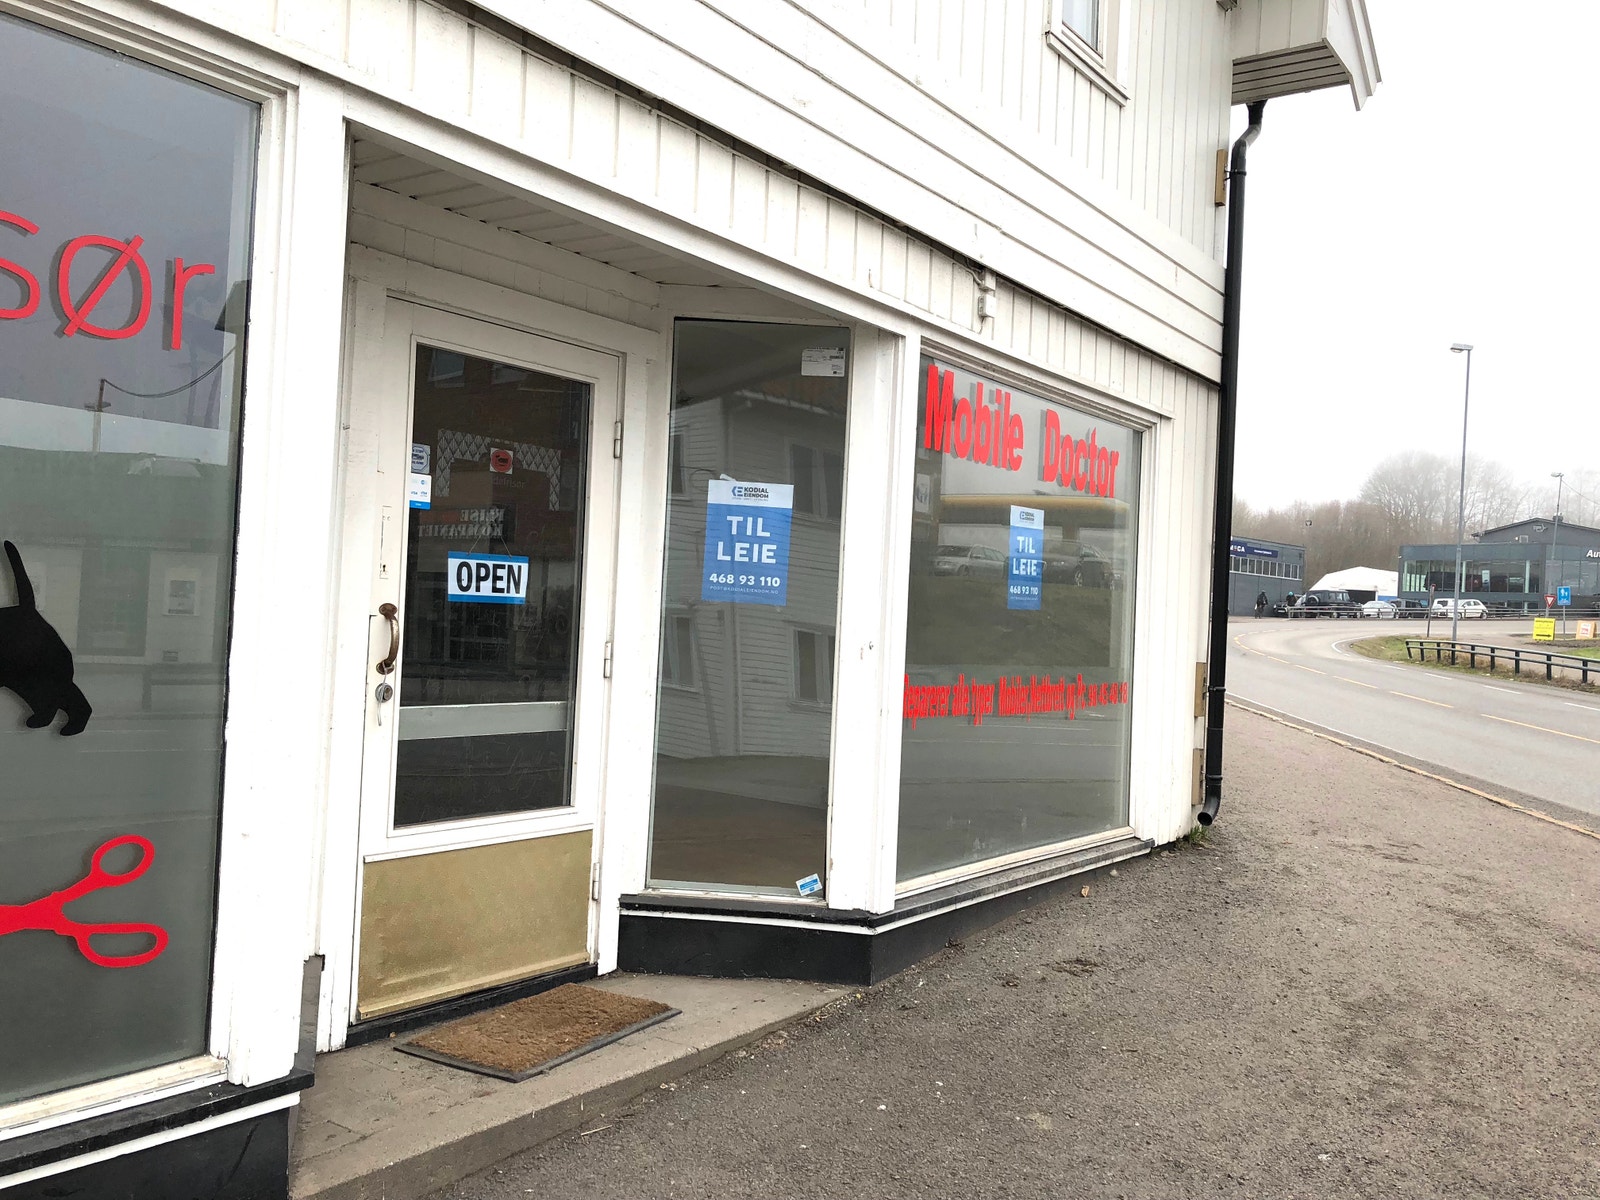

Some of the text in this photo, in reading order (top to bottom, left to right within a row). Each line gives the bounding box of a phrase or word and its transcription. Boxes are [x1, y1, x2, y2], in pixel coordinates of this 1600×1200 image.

[924, 364, 1119, 498] Mobile Doctor
[744, 486, 769, 494] KODIAL
[726, 515, 771, 538] TIL
[717, 541, 777, 564] LEIE
[1016, 535, 1036, 554] TIL
[1012, 557, 1038, 576] LEIE
[456, 561, 522, 595] OPEN
[709, 573, 781, 587] 468 93 110
[1009, 585, 1021, 594] 468
[1022, 586, 1030, 595] 93
[951, 673, 969, 717] alle
[971, 677, 995, 727] typer
